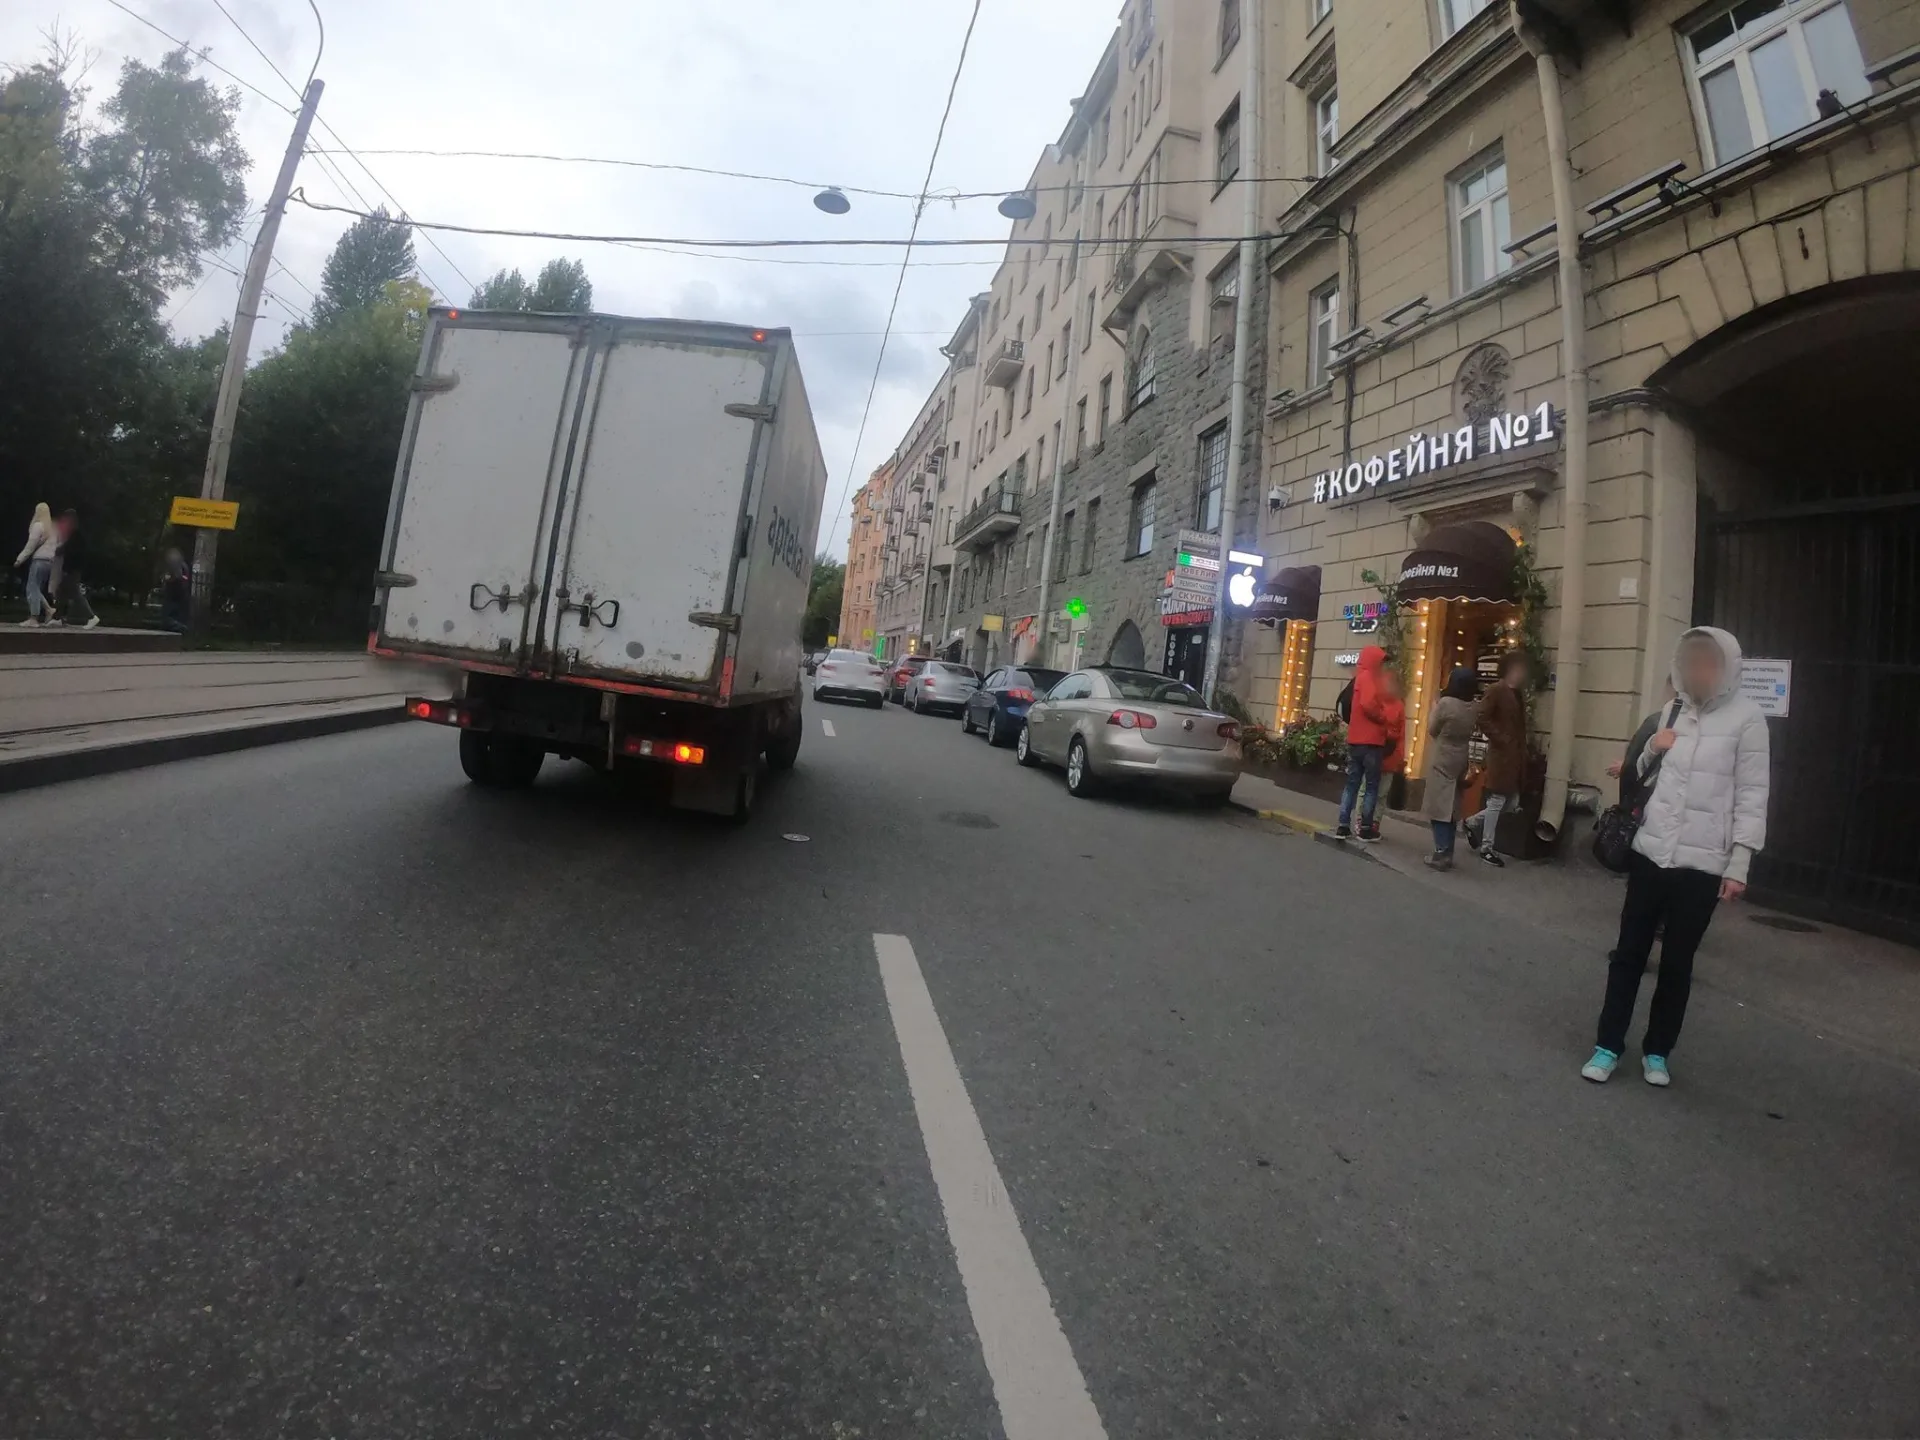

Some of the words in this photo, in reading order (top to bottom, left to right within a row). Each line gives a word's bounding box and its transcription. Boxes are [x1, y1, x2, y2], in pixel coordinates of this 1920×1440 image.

[1314, 425, 1474, 503] #КОФЕЙНЯ
[1489, 401, 1555, 454] №1
[1437, 565, 1459, 578] №1
[1178, 591, 1213, 604] СКУПКА
